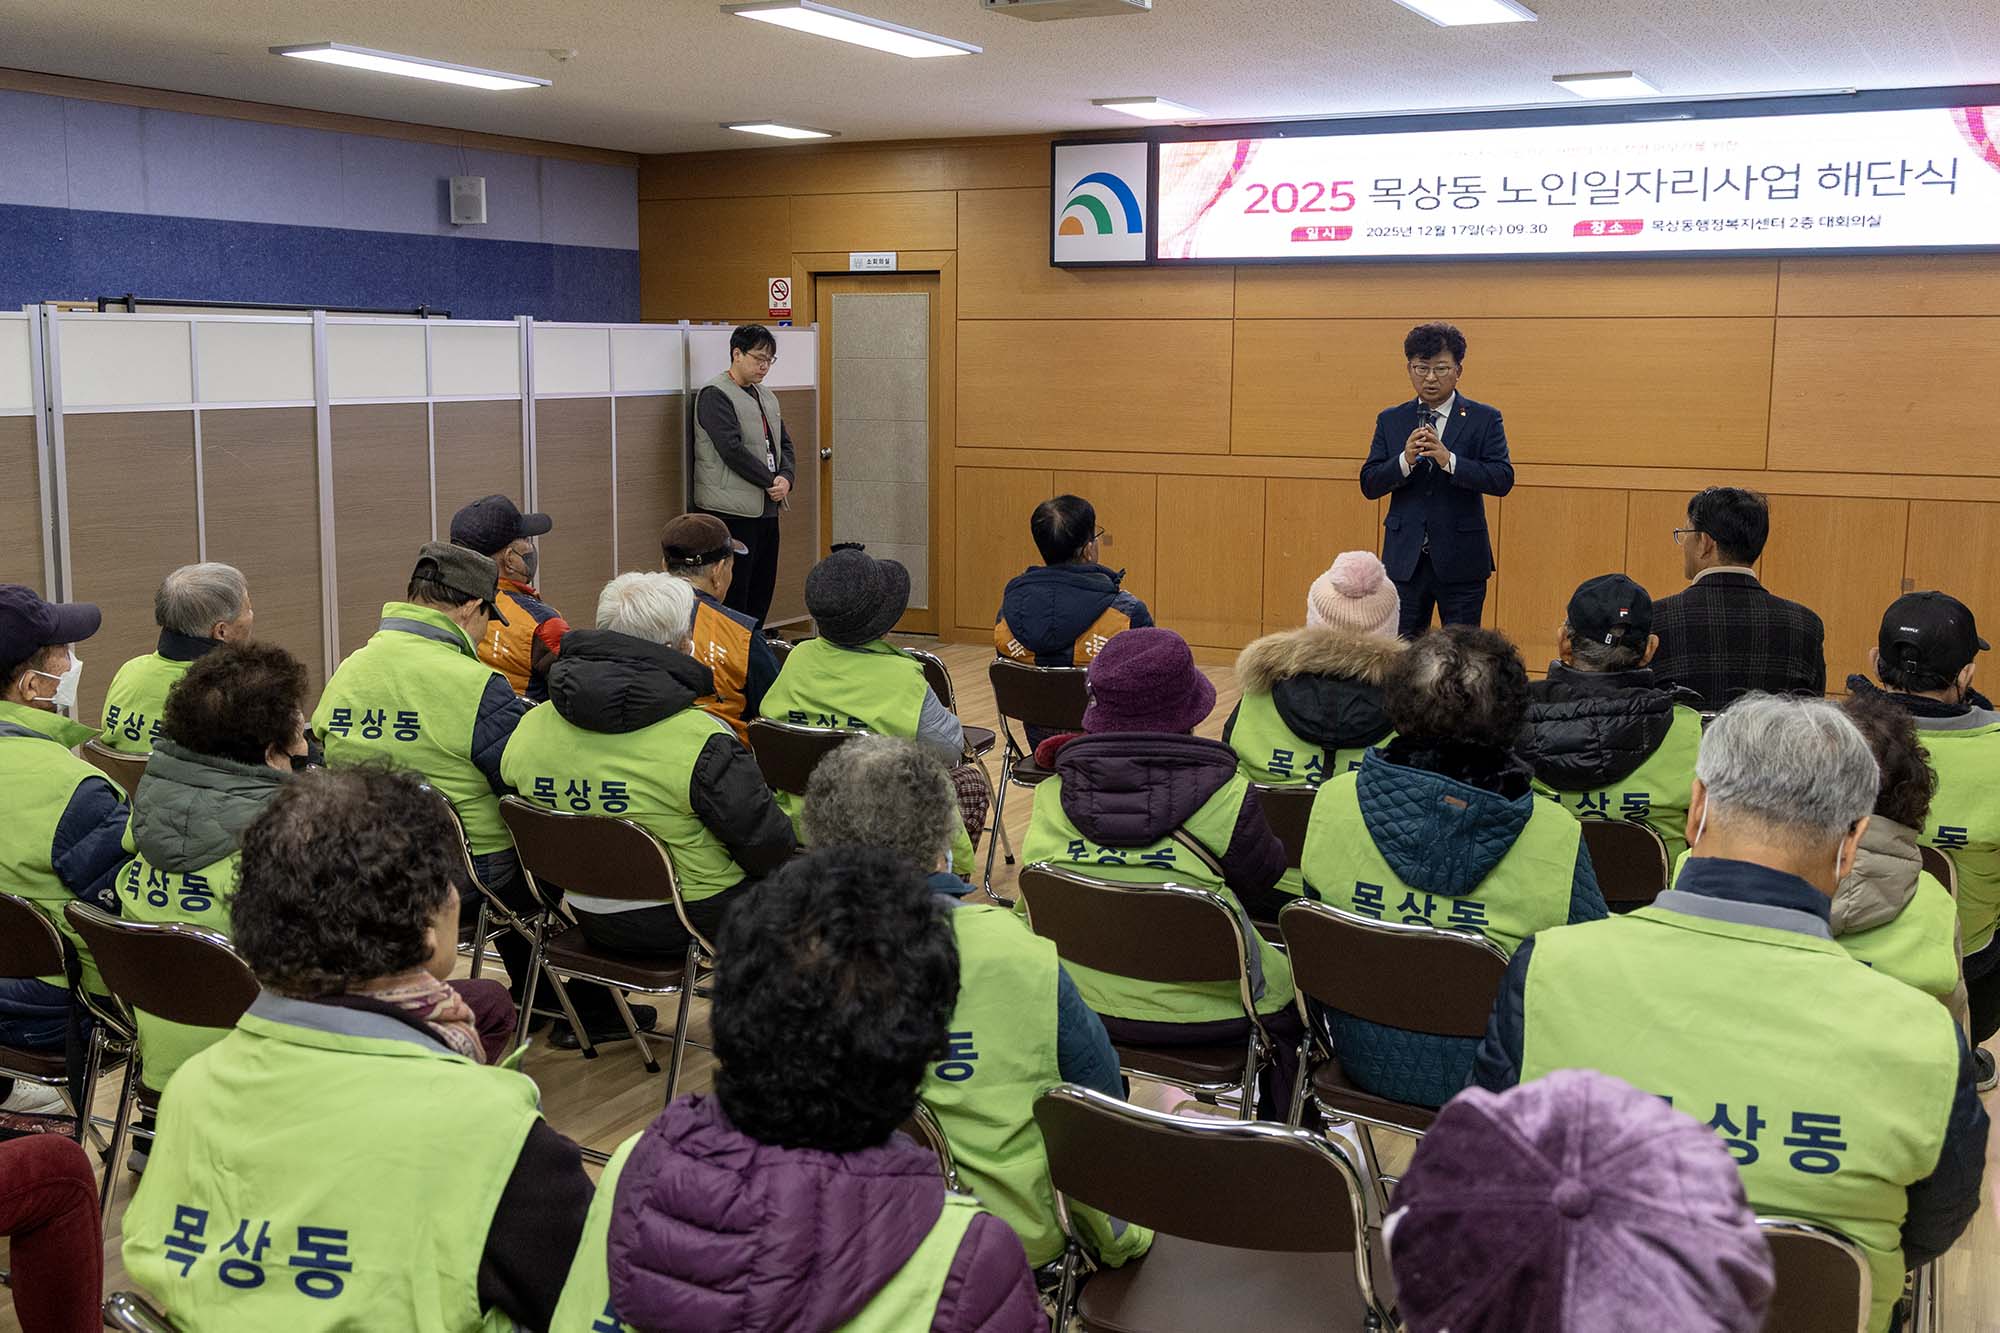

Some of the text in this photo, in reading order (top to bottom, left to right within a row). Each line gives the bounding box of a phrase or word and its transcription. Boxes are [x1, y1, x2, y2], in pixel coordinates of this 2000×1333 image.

[1244, 157, 1958, 214] 2025 목상동 노인일자리사업 해단식
[1306, 227, 1336, 240] 일시
[1366, 226, 1413, 238] 2025년
[1417, 225, 1446, 237] 12월
[1590, 215, 1882, 235] 장소 목상동행정복지센터 2층 대회의실
[328, 708, 421, 742] 목상동
[1267, 748, 1361, 784] 목상
[532, 776, 630, 813] 목상동
[125, 860, 215, 912] 목상동
[1351, 880, 1489, 936] 목상동
[163, 1204, 353, 1299] 목상동
